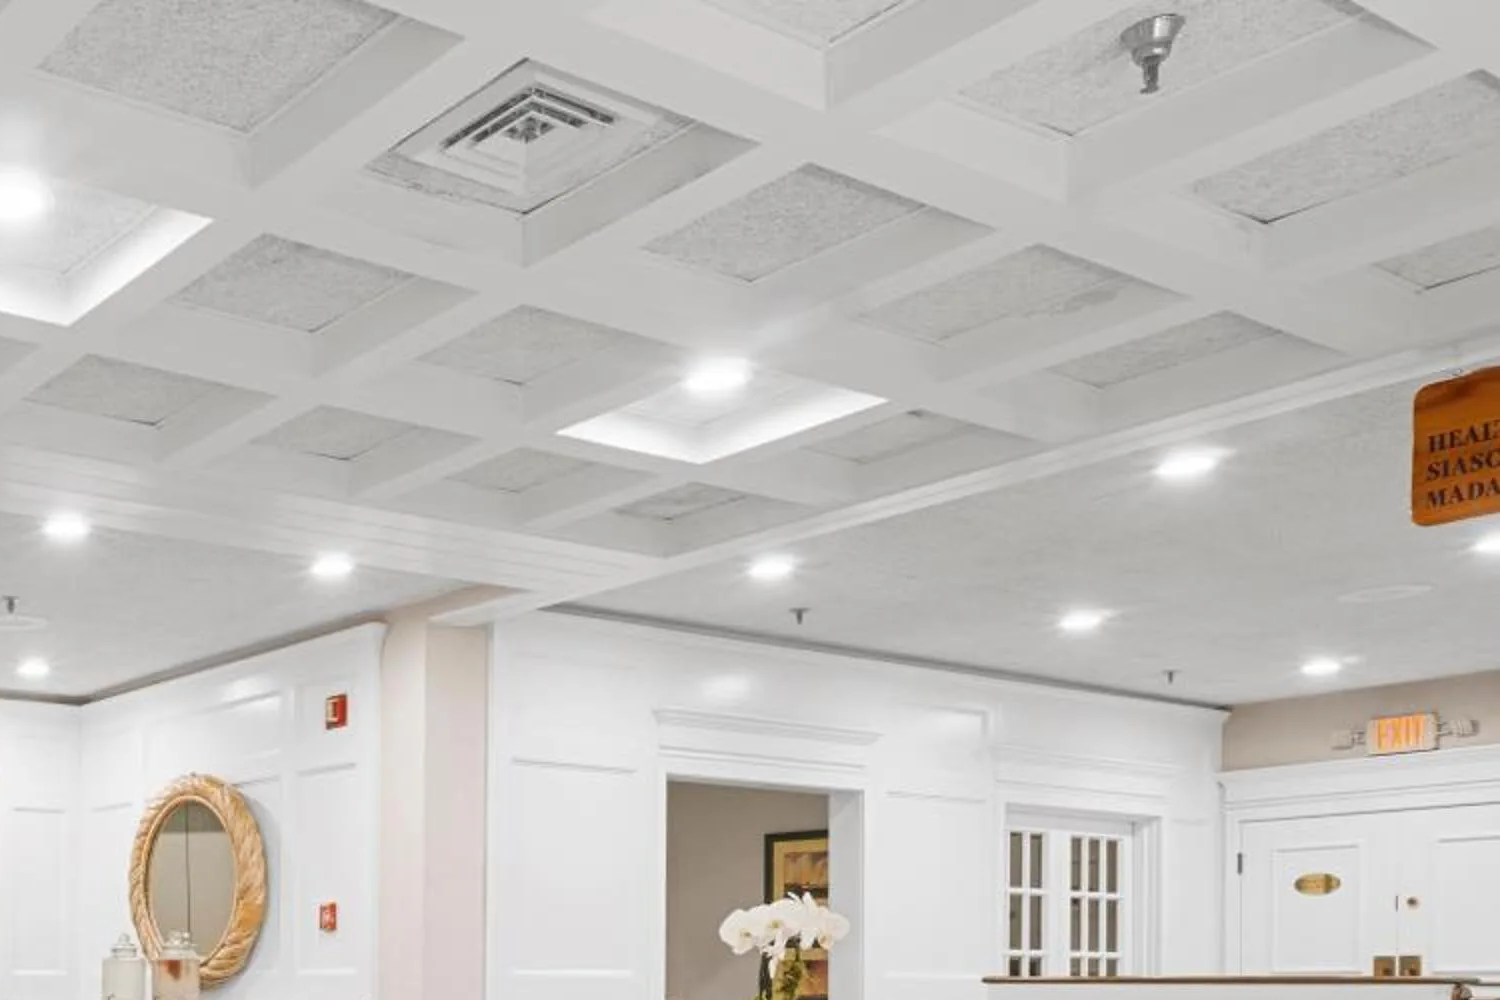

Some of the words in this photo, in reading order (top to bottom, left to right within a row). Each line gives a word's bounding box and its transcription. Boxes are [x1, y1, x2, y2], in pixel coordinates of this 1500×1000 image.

[1426, 448, 1500, 481] SIASC
[1426, 477, 1500, 508] MADA
[1377, 716, 1424, 749] EXIT
